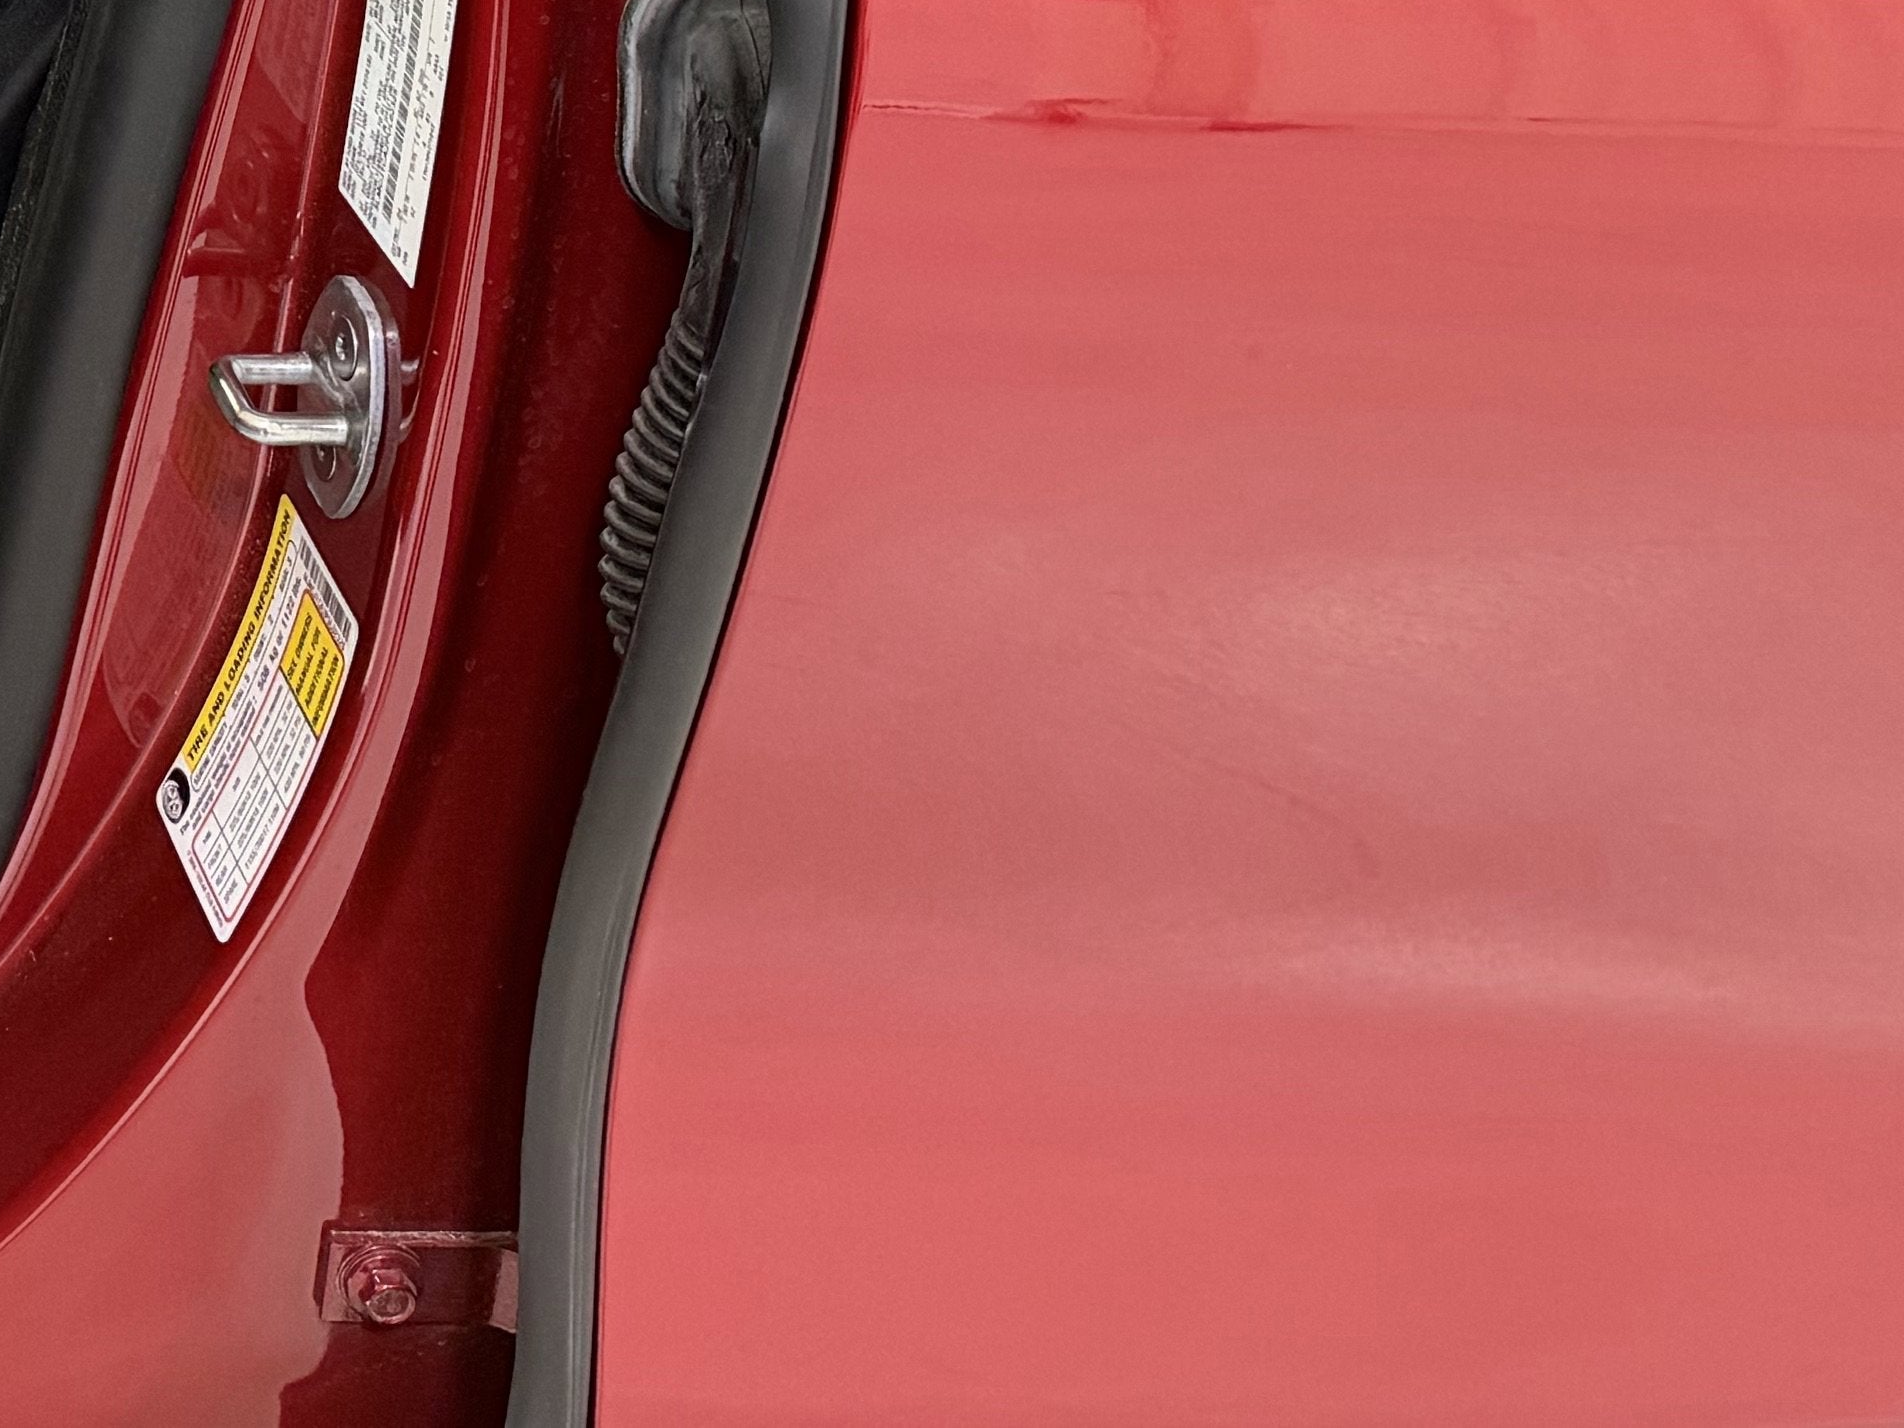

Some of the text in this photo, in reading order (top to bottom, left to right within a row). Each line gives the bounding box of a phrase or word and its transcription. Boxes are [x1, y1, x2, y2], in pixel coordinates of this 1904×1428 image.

[186, 506, 291, 765] TIRE AND LOADING INFORMATION
